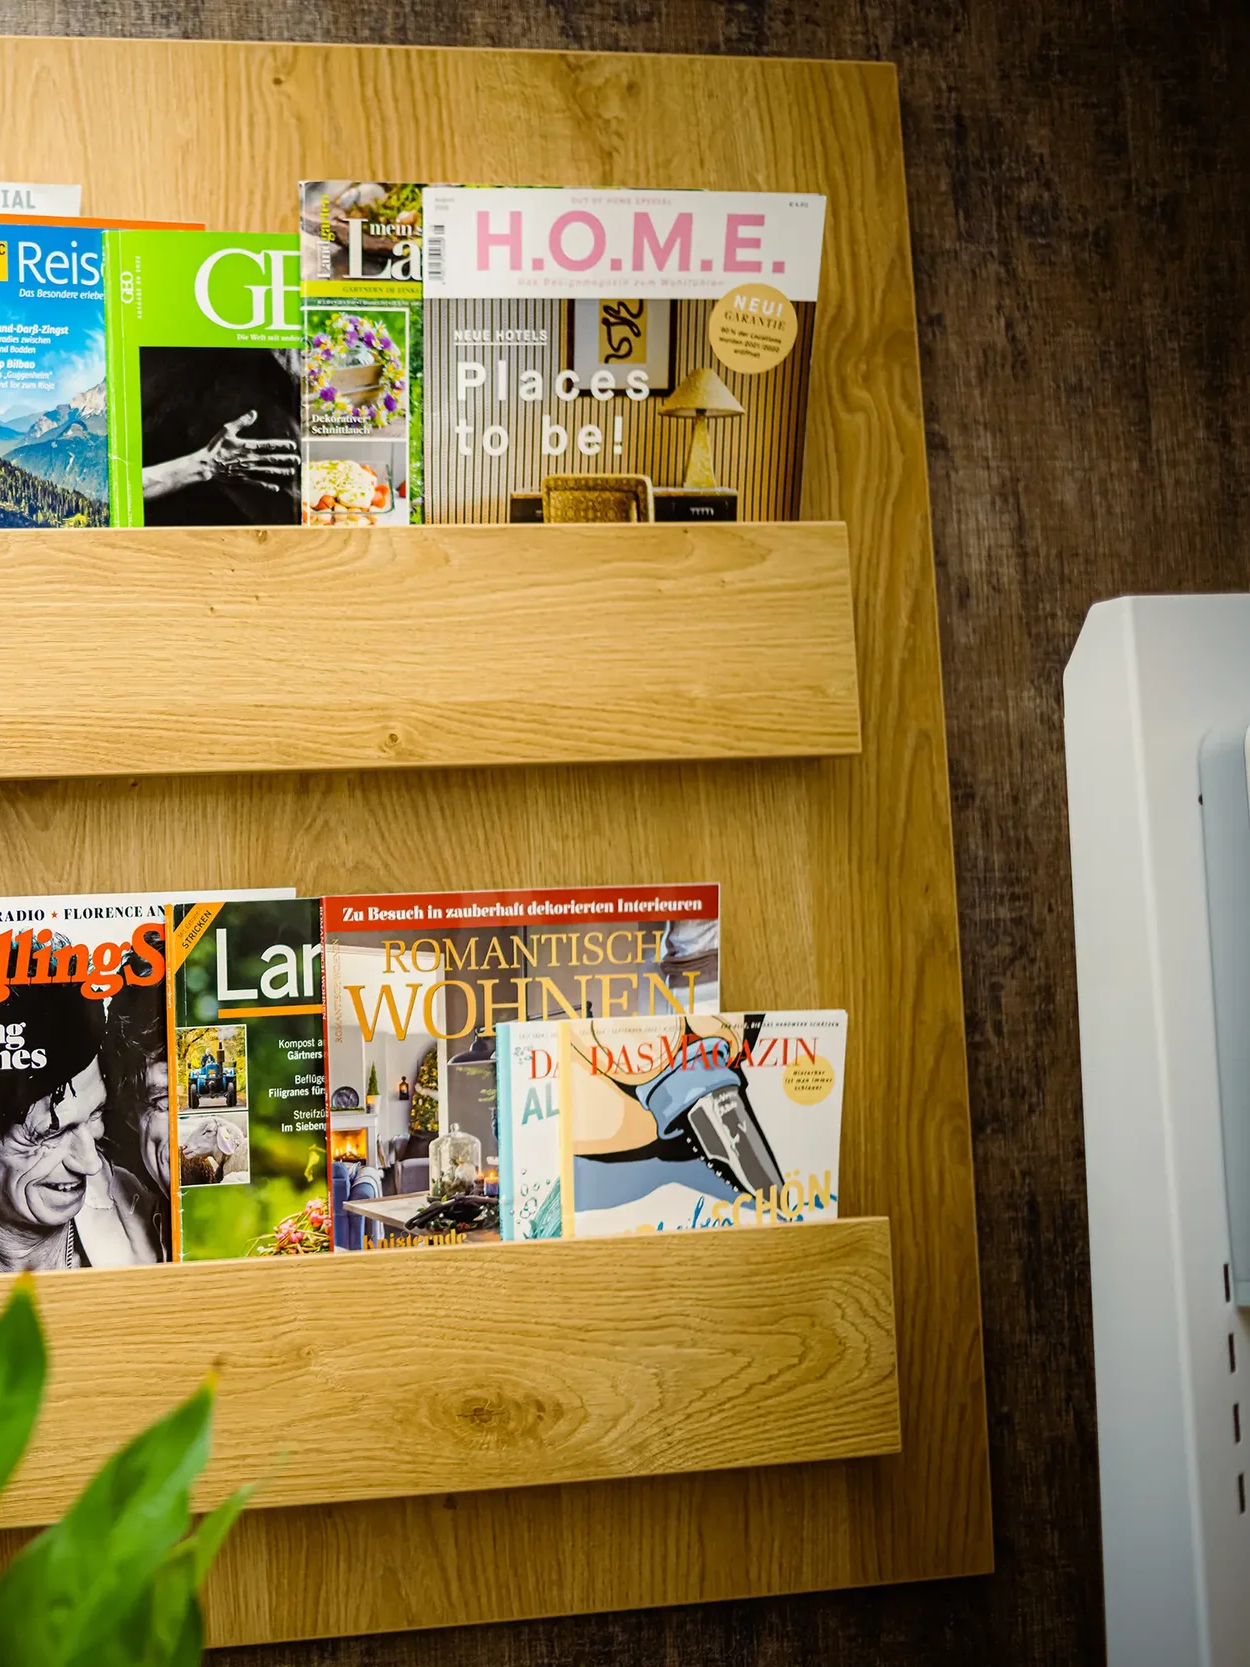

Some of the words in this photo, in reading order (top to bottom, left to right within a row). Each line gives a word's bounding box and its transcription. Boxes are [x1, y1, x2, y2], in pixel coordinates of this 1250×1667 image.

[369, 222, 413, 237] mein
[476, 209, 786, 275] H.O.M.E.
[17, 240, 104, 285] Reis
[19, 288, 35, 298] Das
[36, 288, 79, 300] Besondere
[120, 270, 134, 304] GEO
[194, 247, 302, 331] GE
[733, 293, 785, 318] NEU!
[723, 310, 787, 332] GARANTIE
[20, 335, 51, 344] zwischen
[454, 328, 491, 342] NEUE
[495, 329, 549, 342] HOTELS
[9, 346, 37, 355] Bodden
[6, 359, 36, 370] Bilbao
[456, 360, 651, 402] Places
[312, 413, 369, 424] Dekorativer
[311, 425, 371, 436] Schnittlauch
[454, 419, 510, 457] to
[542, 415, 625, 457] be!
[63, 905, 143, 921] FLORENCE
[342, 905, 364, 923] Zu
[367, 904, 424, 922] Besuch
[427, 903, 442, 919] in
[445, 901, 525, 919] zauberhaft
[527, 898, 614, 916] dekorierten
[617, 896, 703, 914] Interieuren
[181, 908, 213, 950] STRICKEN
[381, 929, 664, 974] ROMANTISCH
[343, 970, 702, 1043] WOHNEN
[278, 1037, 315, 1050] Kompost
[286, 1049, 323, 1062] Gärtners
[268, 1085, 309, 1099] Filigranes
[293, 1108, 326, 1120] Streifzü
[281, 1122, 293, 1133] Im
